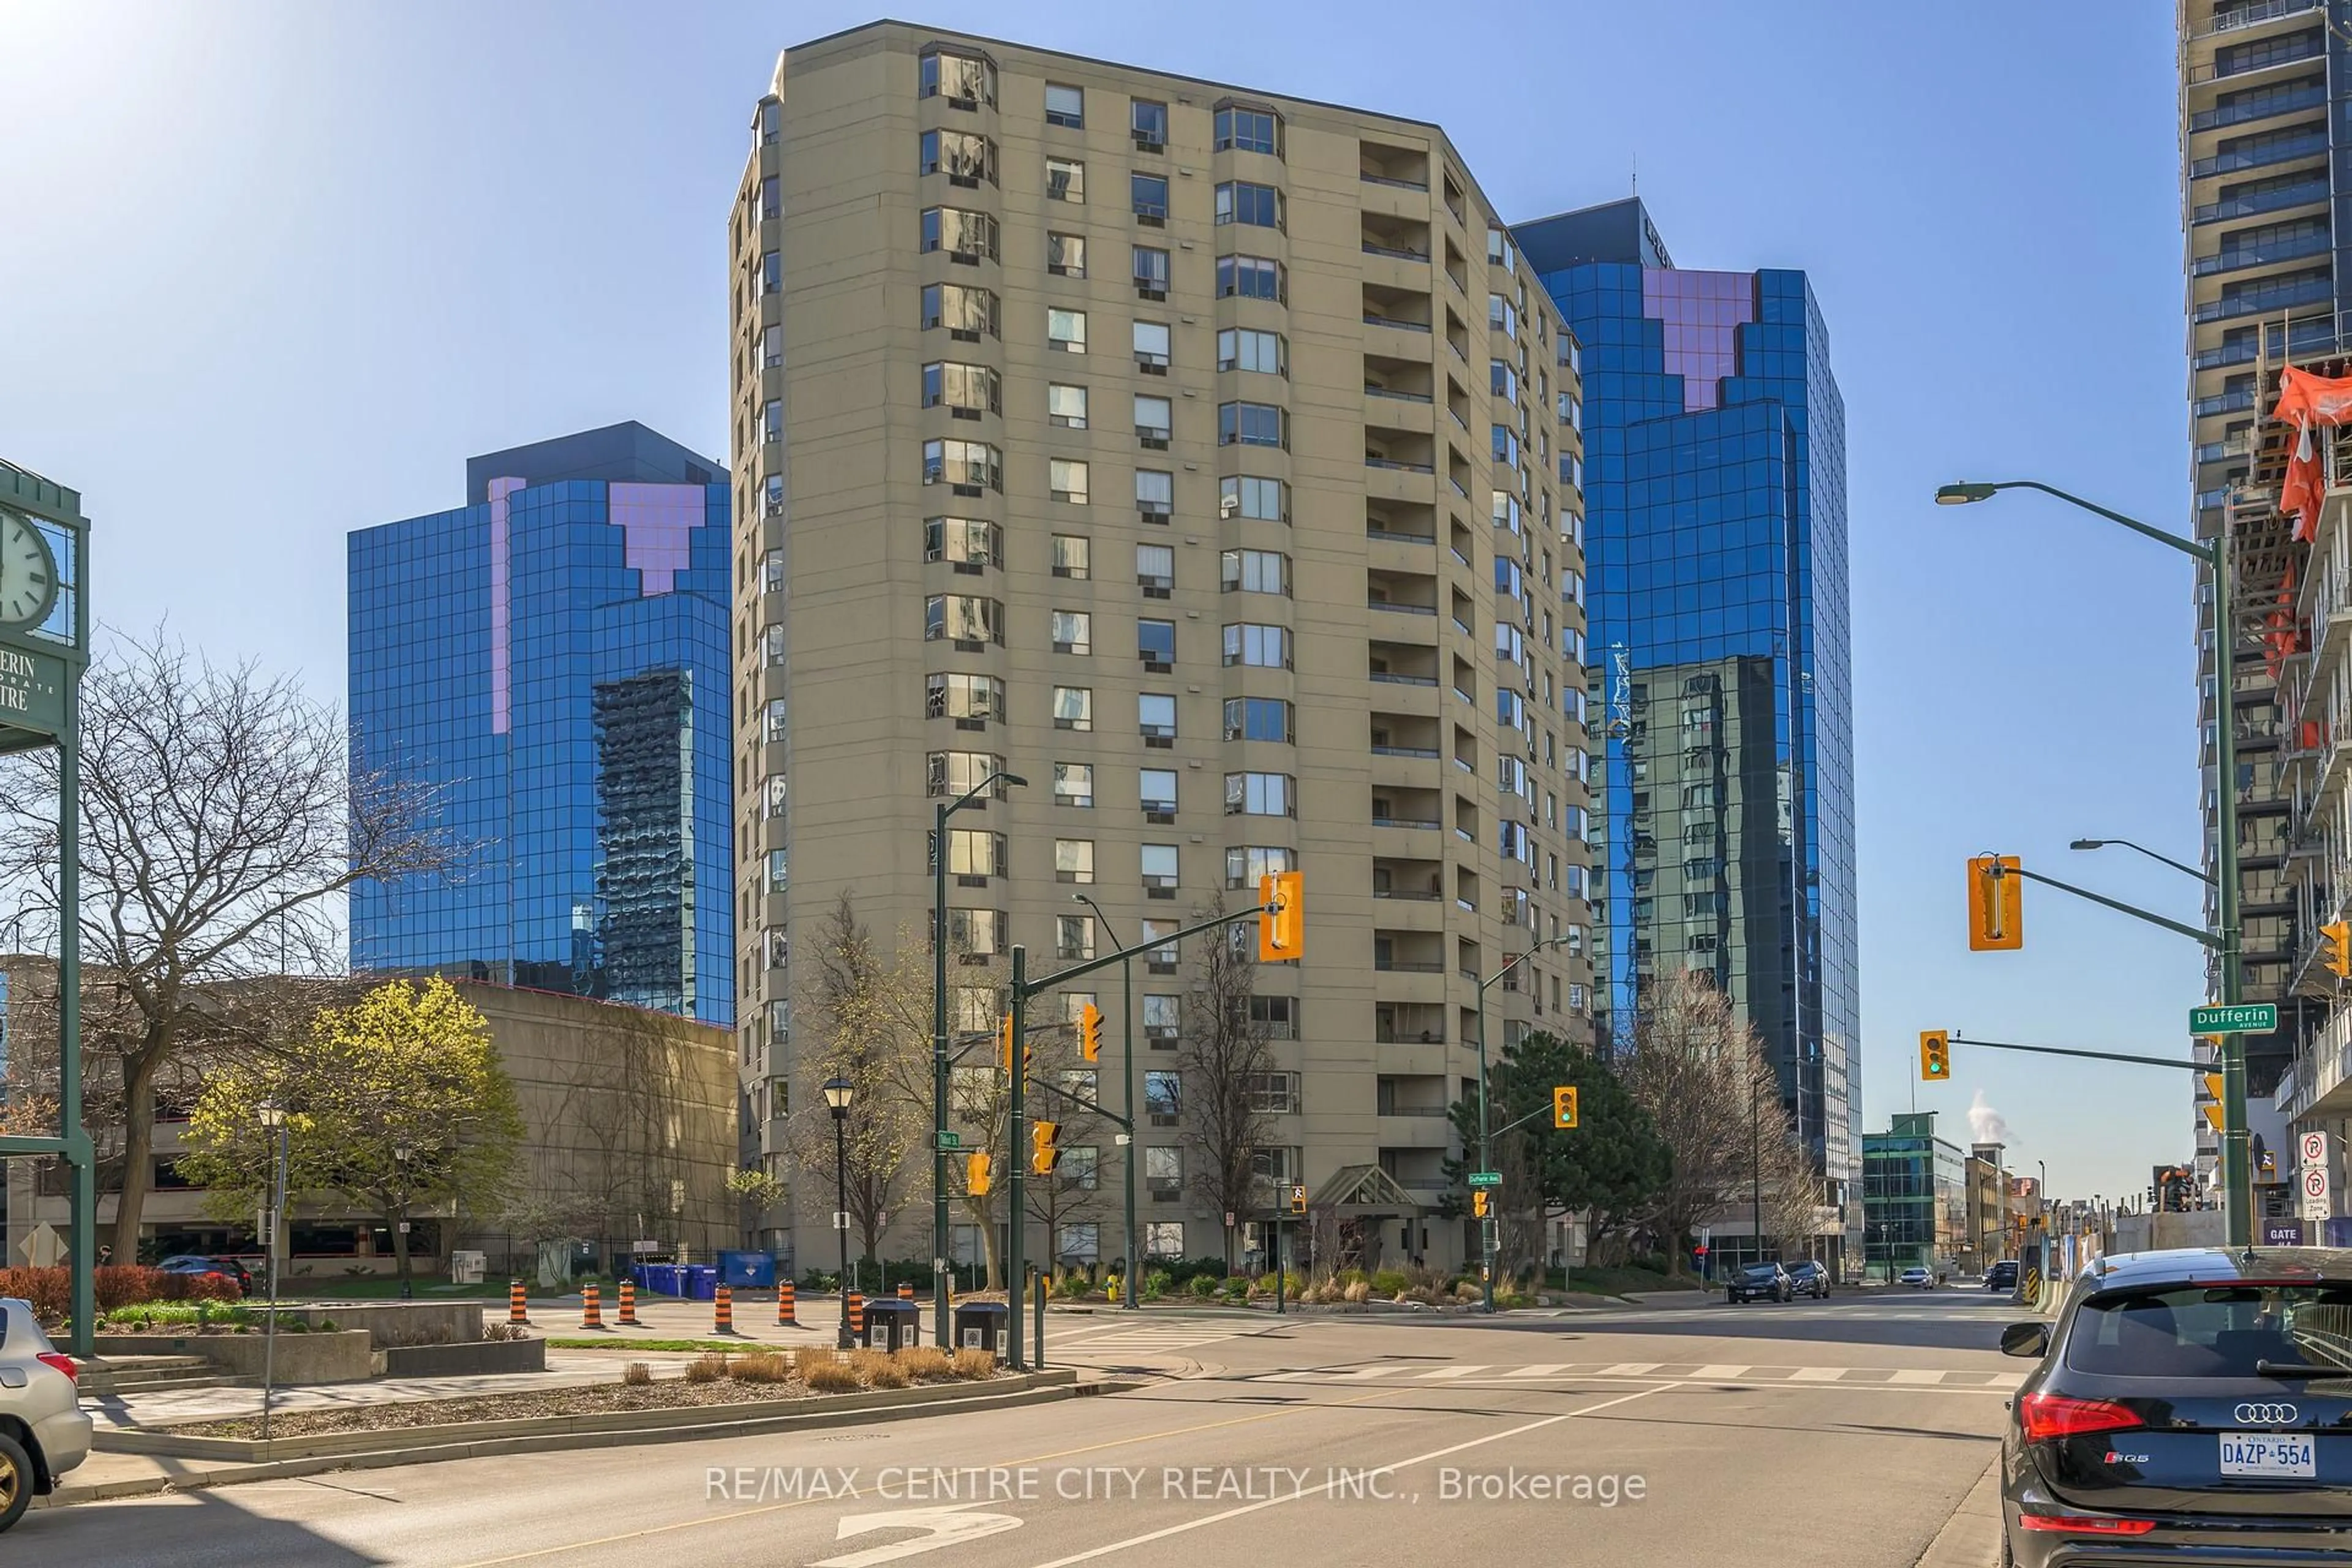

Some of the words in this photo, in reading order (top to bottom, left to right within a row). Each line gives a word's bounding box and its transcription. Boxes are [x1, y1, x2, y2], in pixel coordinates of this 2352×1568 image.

[2197, 1009, 2267, 1023] Dufferin
[2271, 1229, 2297, 1239] GATE
[2112, 1454, 2149, 1463] SQ5
[2223, 1444, 2266, 1464] DAZP
[2277, 1445, 2310, 1465] 554
